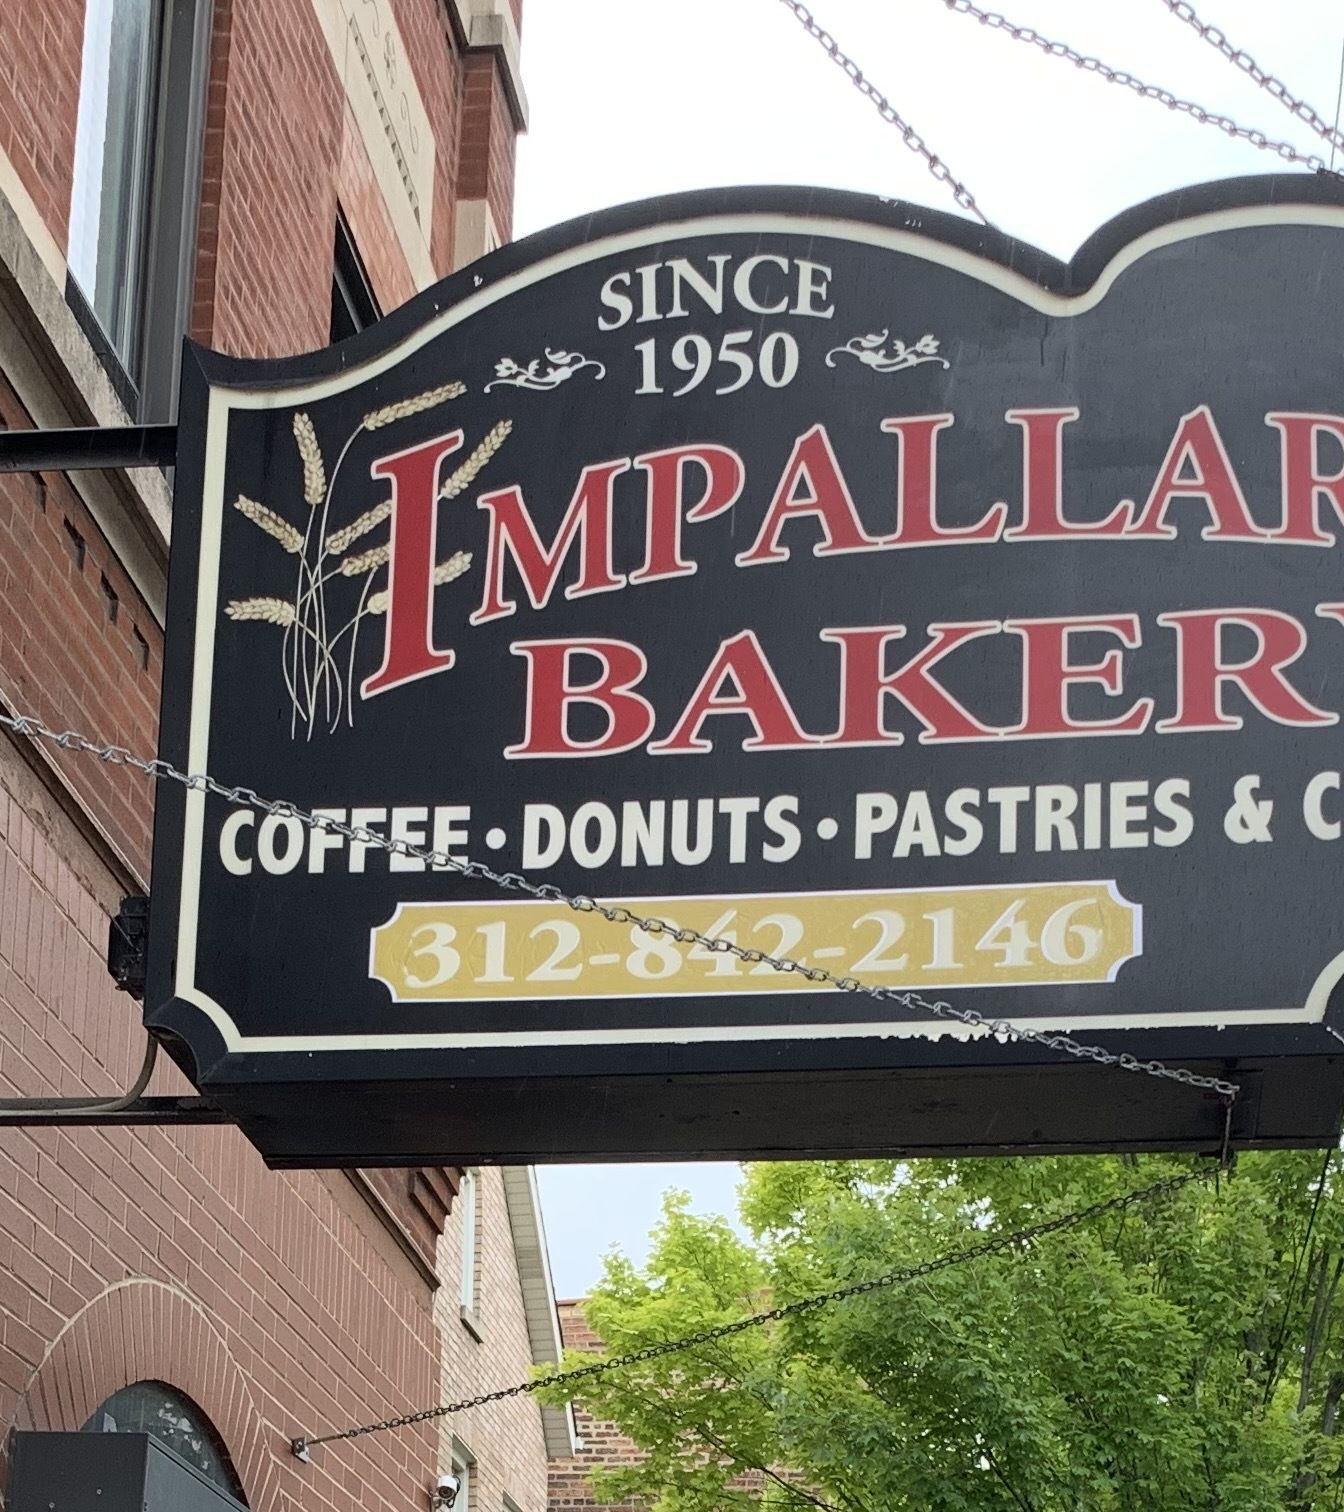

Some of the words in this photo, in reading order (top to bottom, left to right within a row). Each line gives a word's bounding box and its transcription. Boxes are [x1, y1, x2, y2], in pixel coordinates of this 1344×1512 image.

[597, 255, 835, 335] SINCE
[633, 330, 800, 398] 1950
[219, 805, 470, 875] COFFEE
[523, 795, 801, 870] DONUTS
[855, 778, 1194, 859] PASTRIES
[1223, 774, 1274, 844] &
[404, 897, 1104, 990] 312-842-2146
